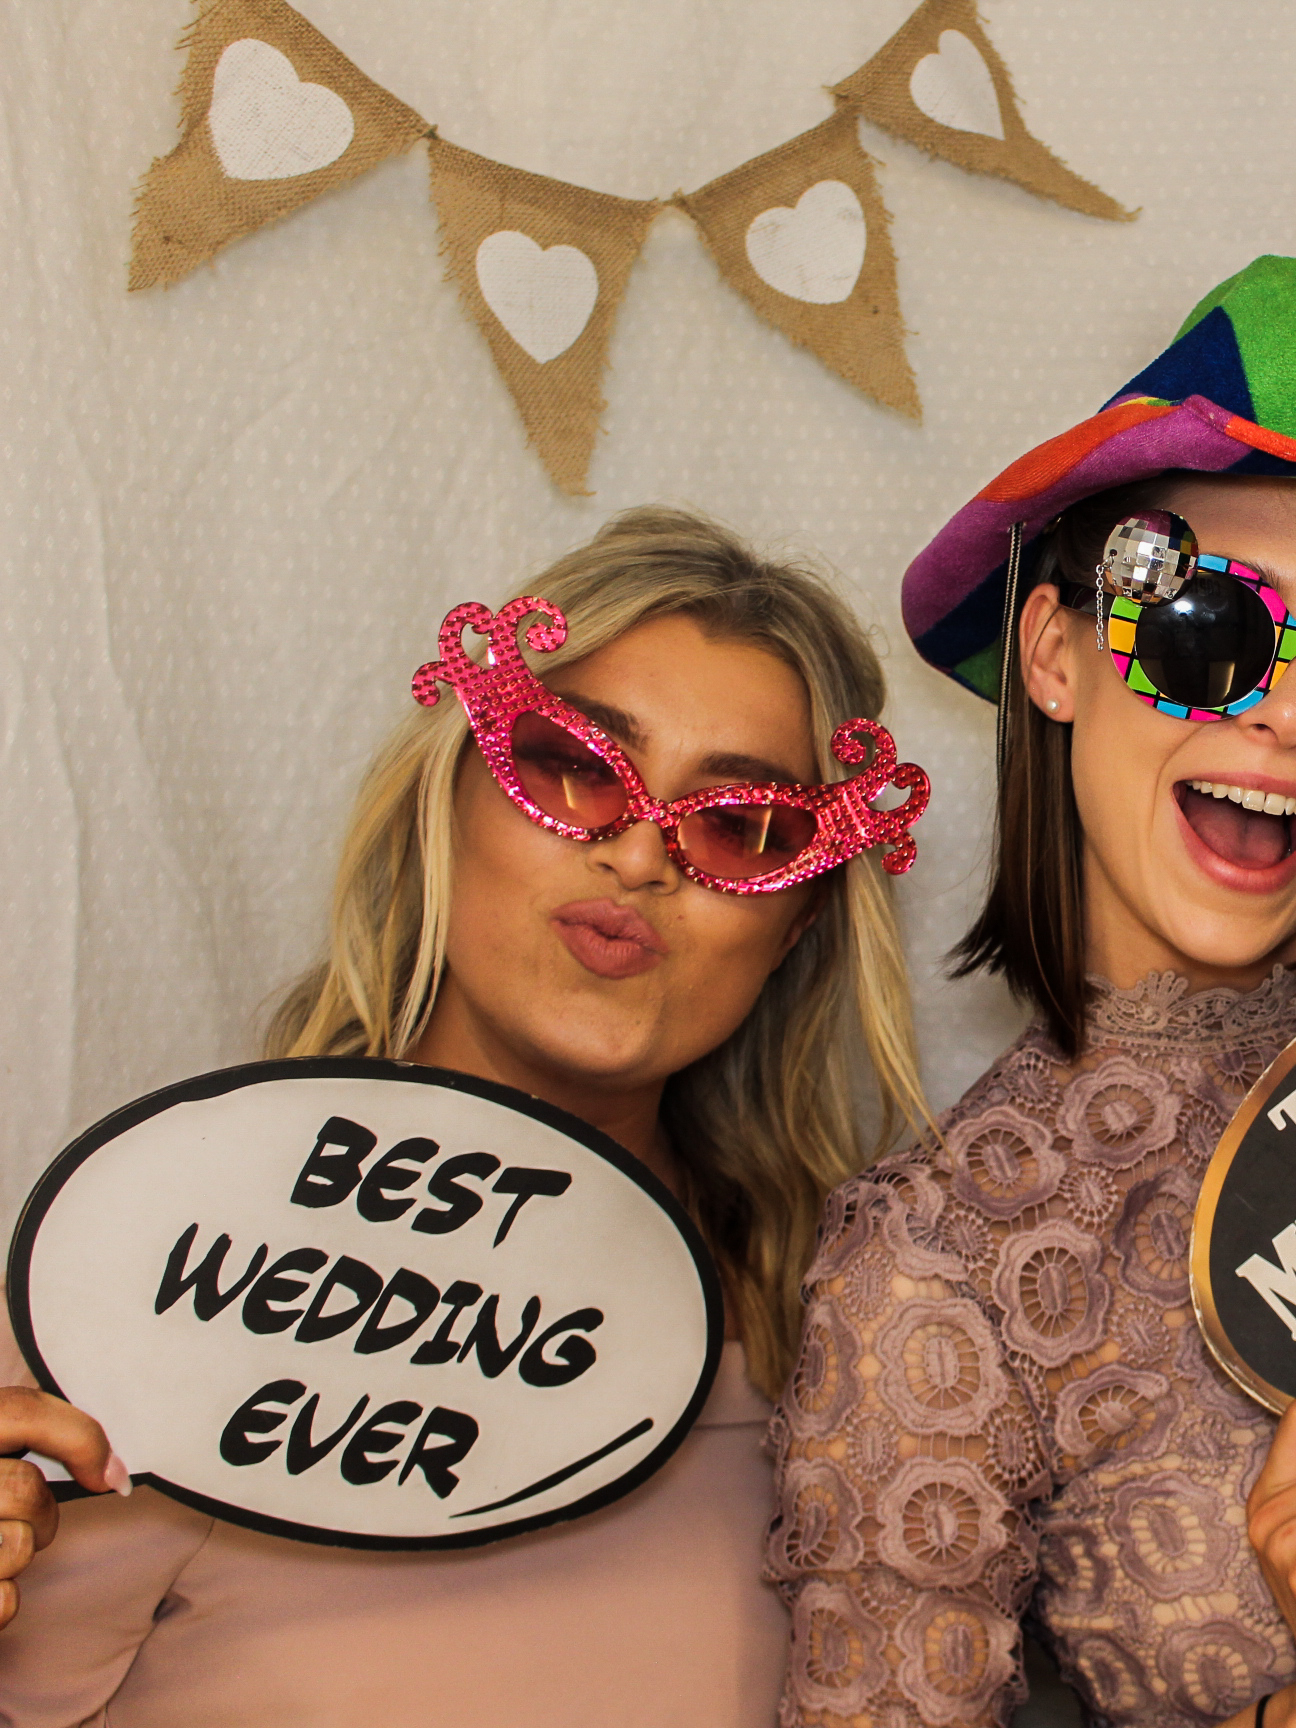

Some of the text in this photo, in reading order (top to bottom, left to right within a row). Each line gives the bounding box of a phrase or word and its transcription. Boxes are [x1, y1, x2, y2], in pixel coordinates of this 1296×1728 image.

[289, 1116, 572, 1248] BEST
[154, 1222, 604, 1387] WEDDING
[219, 1379, 479, 1499] EVER
